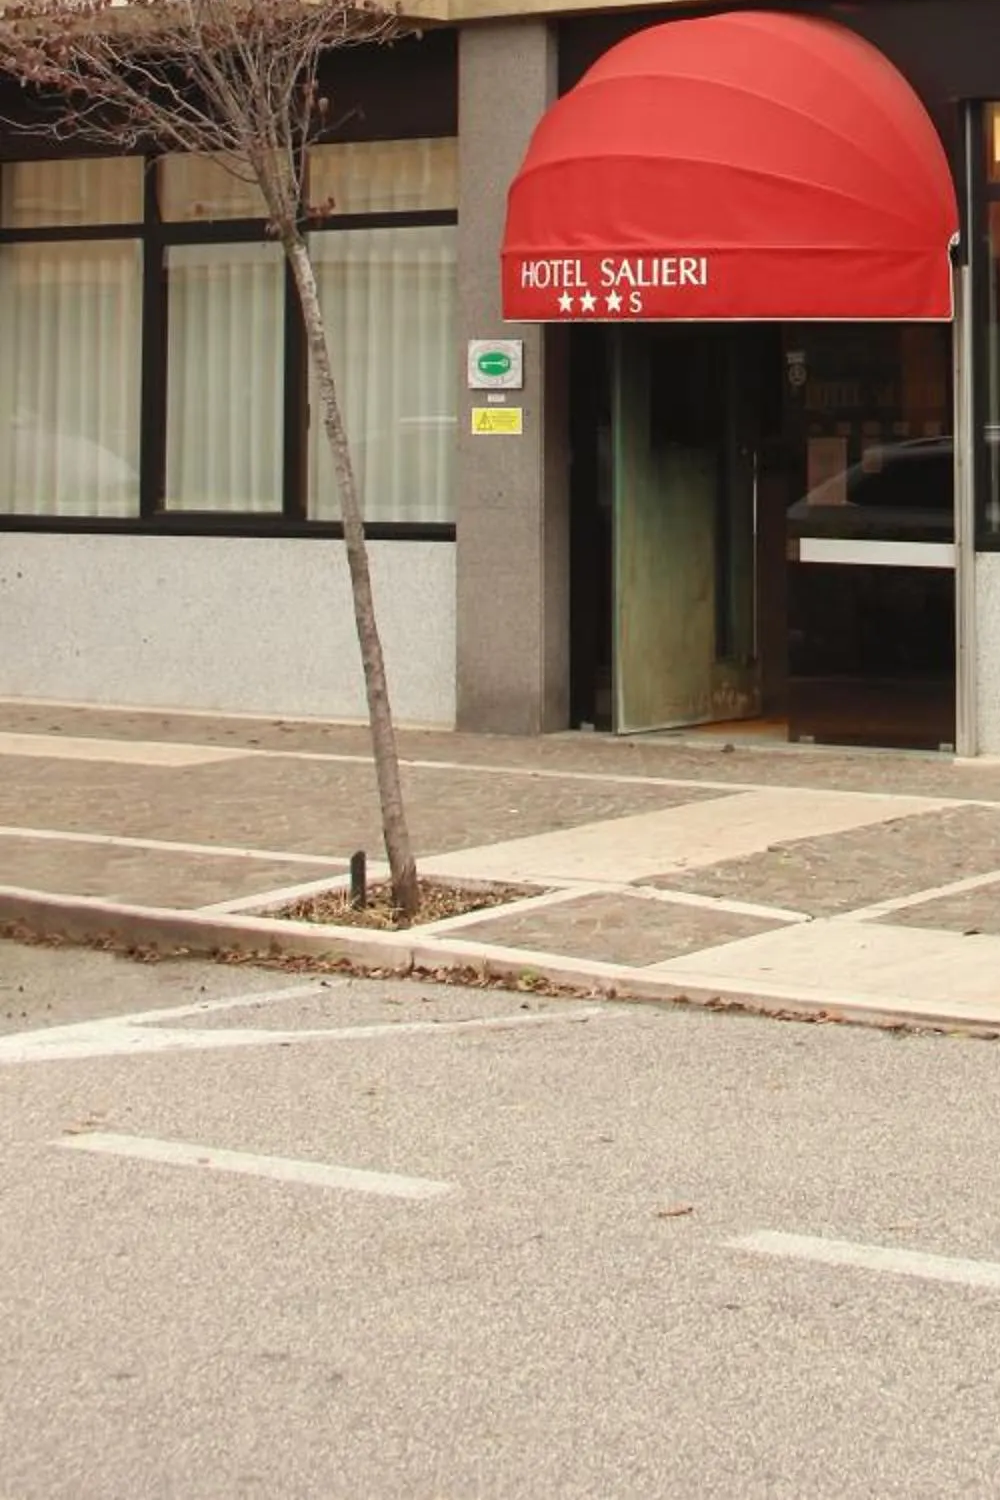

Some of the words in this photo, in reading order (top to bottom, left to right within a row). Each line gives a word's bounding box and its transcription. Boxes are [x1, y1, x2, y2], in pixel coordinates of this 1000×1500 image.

[521, 260, 588, 288] HOTEL
[600, 257, 707, 287] SALIERI
[629, 292, 643, 313] S
